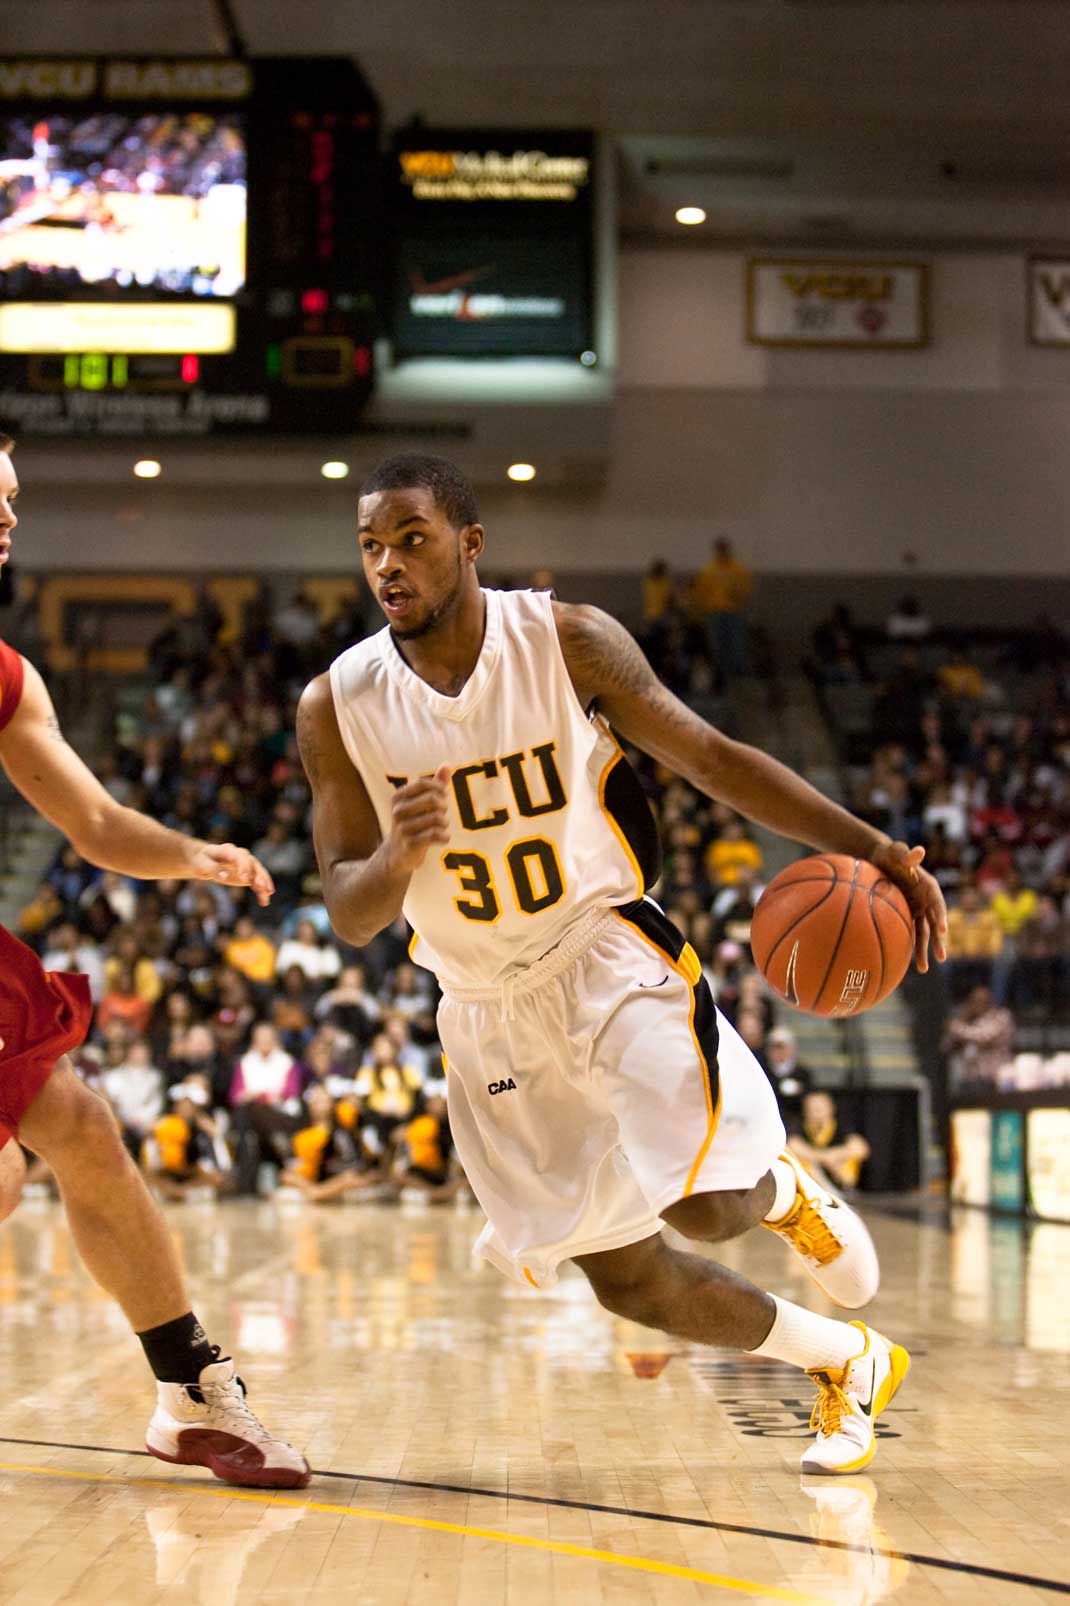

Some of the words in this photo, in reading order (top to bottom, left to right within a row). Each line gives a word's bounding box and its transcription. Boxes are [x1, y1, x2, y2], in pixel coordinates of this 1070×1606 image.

[386, 741, 568, 831] CU
[440, 835, 567, 925] 30
[487, 1077, 518, 1096] CAA
